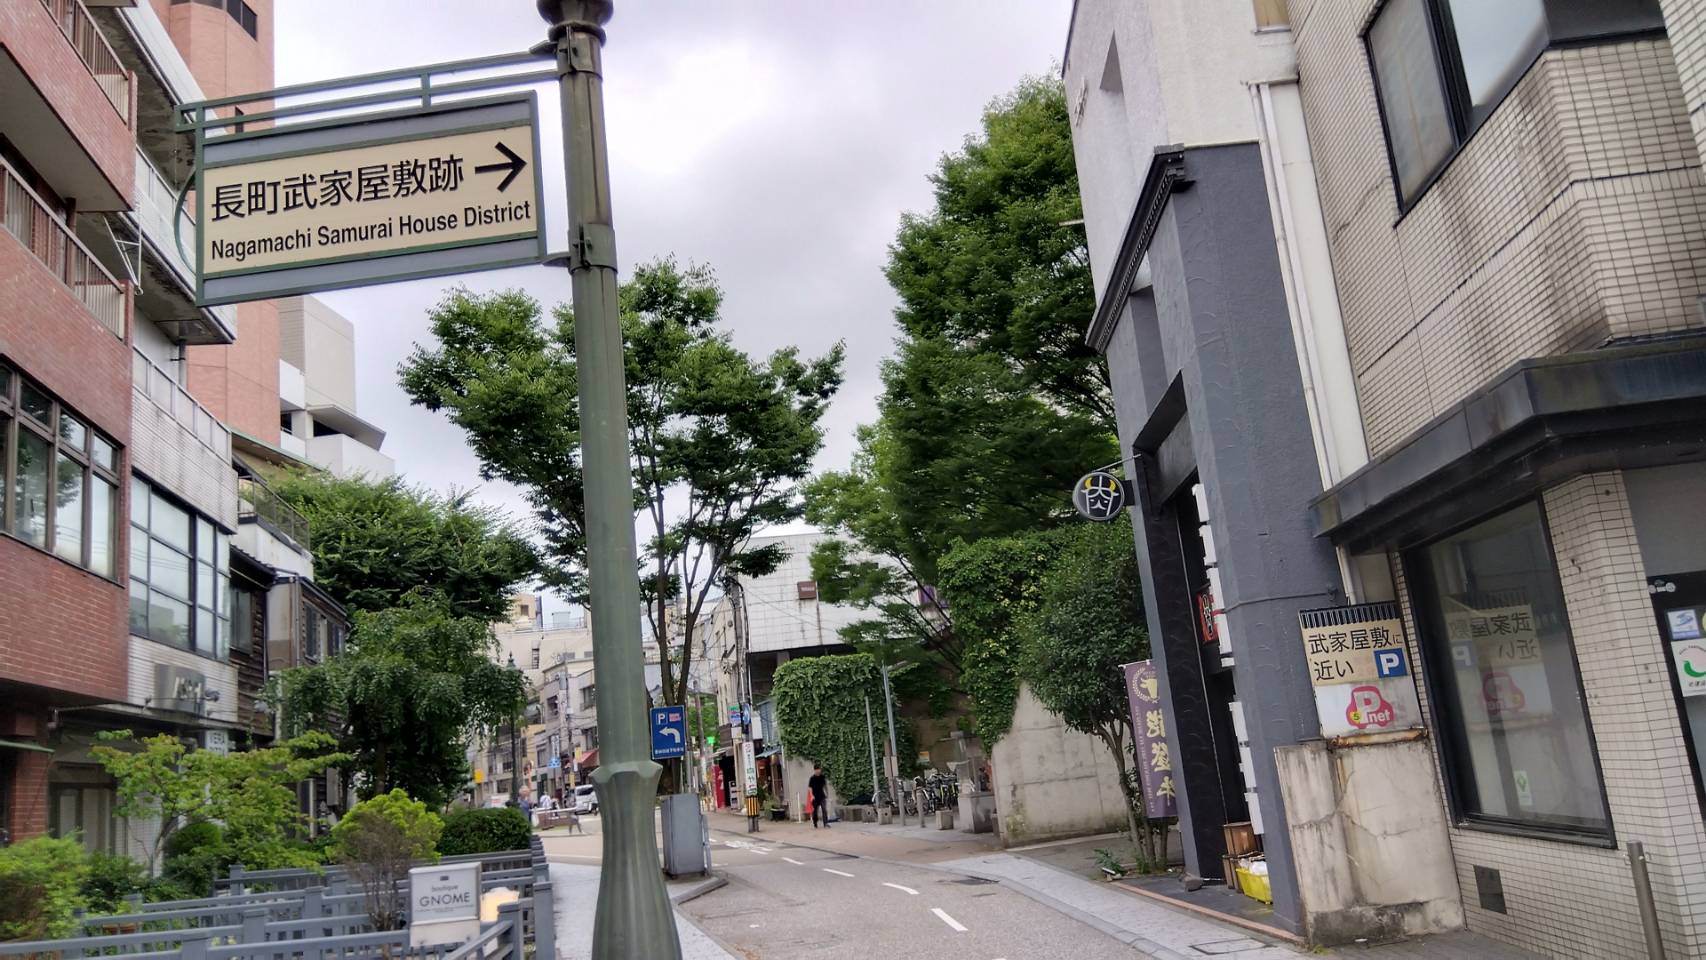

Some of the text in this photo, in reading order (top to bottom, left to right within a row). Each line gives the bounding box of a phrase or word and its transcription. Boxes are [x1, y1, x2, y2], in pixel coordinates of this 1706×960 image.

[211, 154, 465, 222] 長町武家屋敷跡
[211, 200, 532, 262] Nagamachi Samurai House District
[1308, 626, 1403, 655] 武家屋敷に
[1313, 660, 1355, 681] 近い
[1379, 652, 1400, 675] P
[658, 713, 666, 725] P
[419, 891, 471, 907] GNOME
